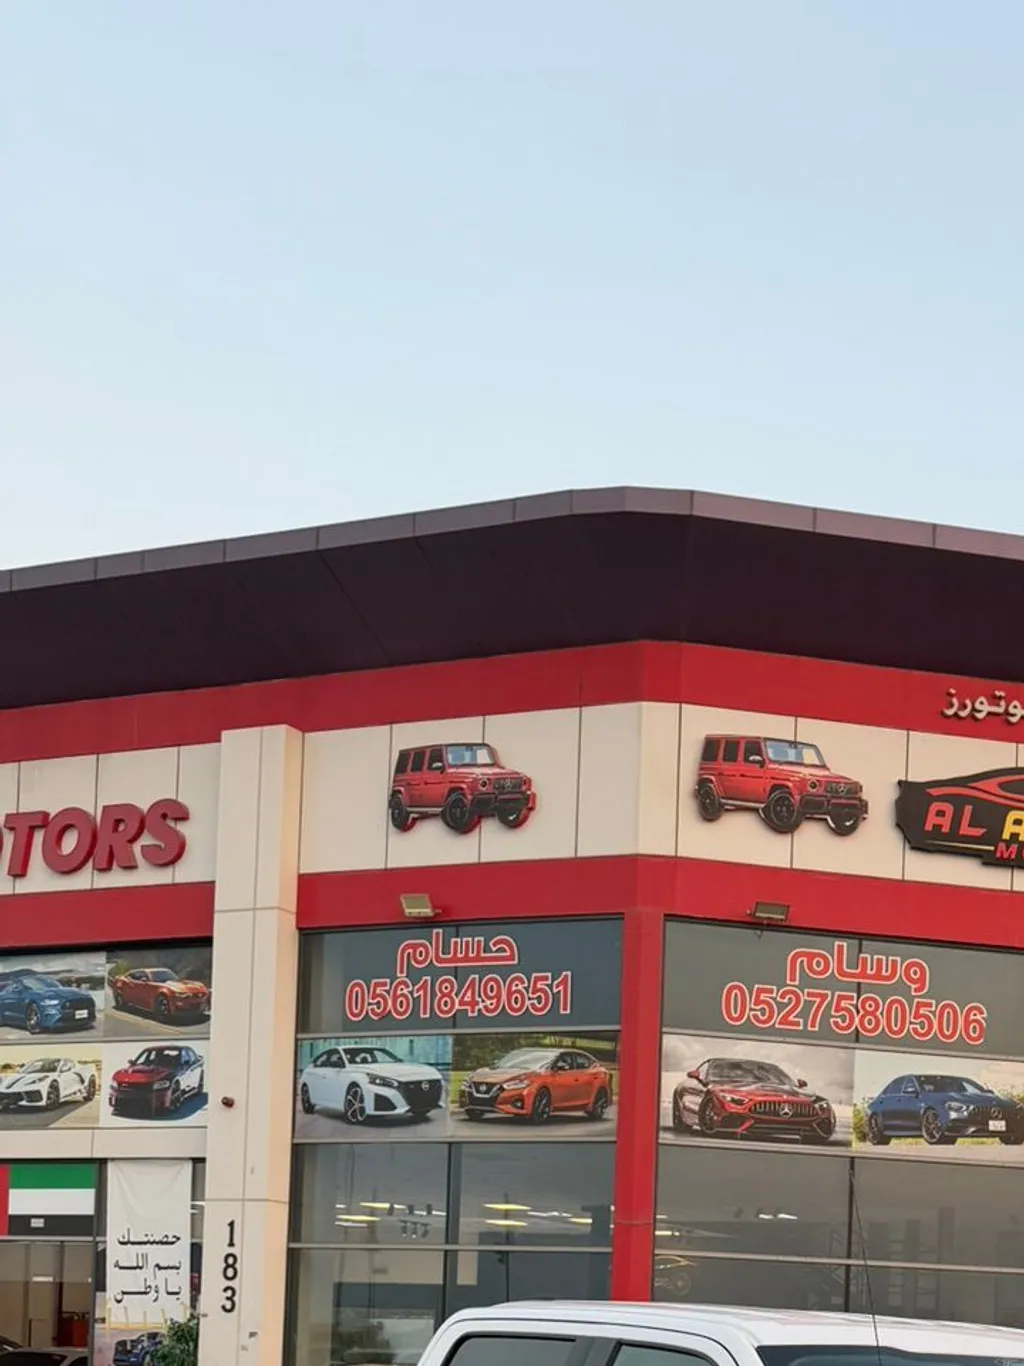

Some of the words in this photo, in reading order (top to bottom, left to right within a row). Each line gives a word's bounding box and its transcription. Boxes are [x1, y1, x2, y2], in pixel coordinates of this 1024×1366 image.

[924, 801, 989, 837] AL
[0, 798, 190, 878] TORS
[396, 928, 519, 977] حسام
[786, 940, 930, 996] وسام
[345, 971, 572, 1022] 0561849651
[721, 981, 988, 1046] 0527580506
[116, 1228, 182, 1246] حصنتك
[113, 1252, 149, 1271] الله
[153, 1259, 182, 1280] بسم
[113, 1277, 160, 1304] وطن
[165, 1277, 182, 1301] يا
